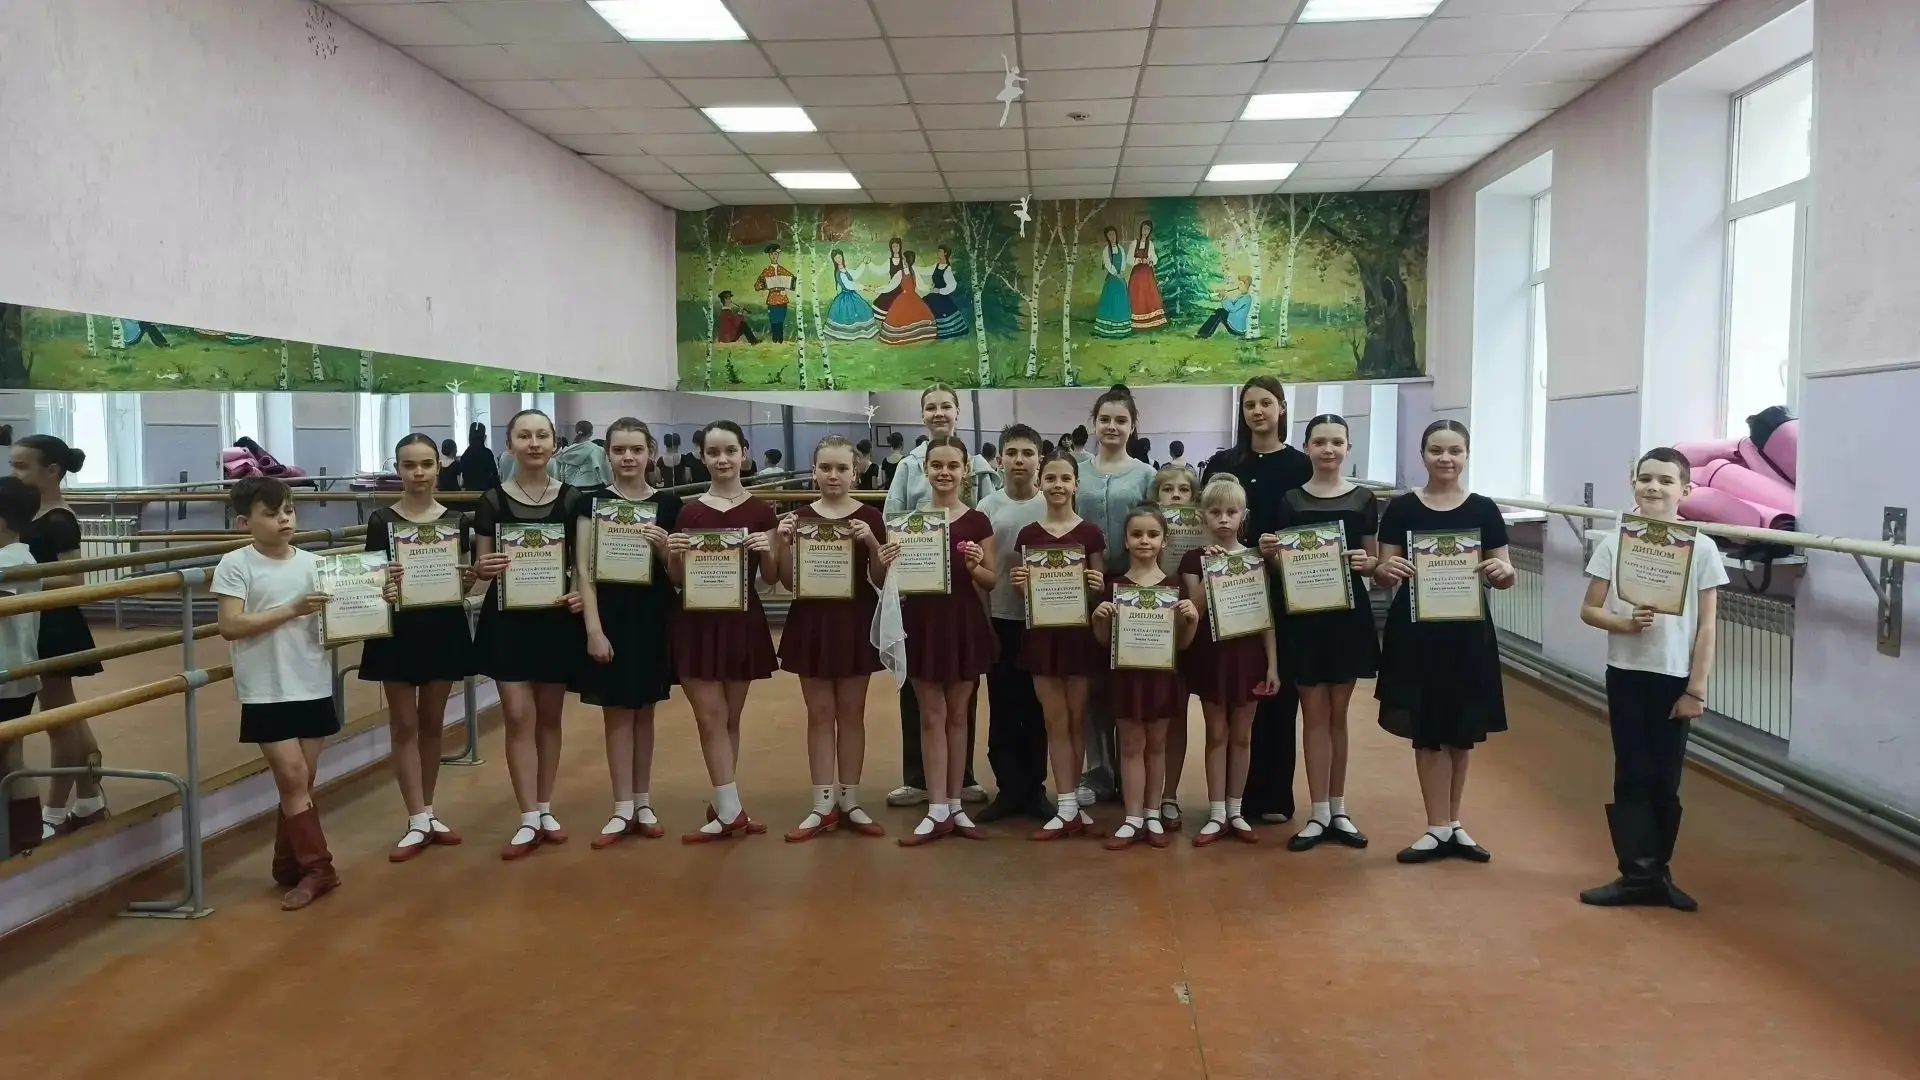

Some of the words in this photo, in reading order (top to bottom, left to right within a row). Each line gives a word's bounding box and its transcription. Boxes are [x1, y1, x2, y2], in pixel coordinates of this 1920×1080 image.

[409, 547, 447, 556] ДИПЛОМ
[1632, 545, 1675, 559] ДИПЛОМ
[1293, 552, 1328, 562] ДИПЛОМ
[1428, 560, 1466, 568] ДИПЛОМ
[1222, 577, 1255, 588] ДИПЛОМ
